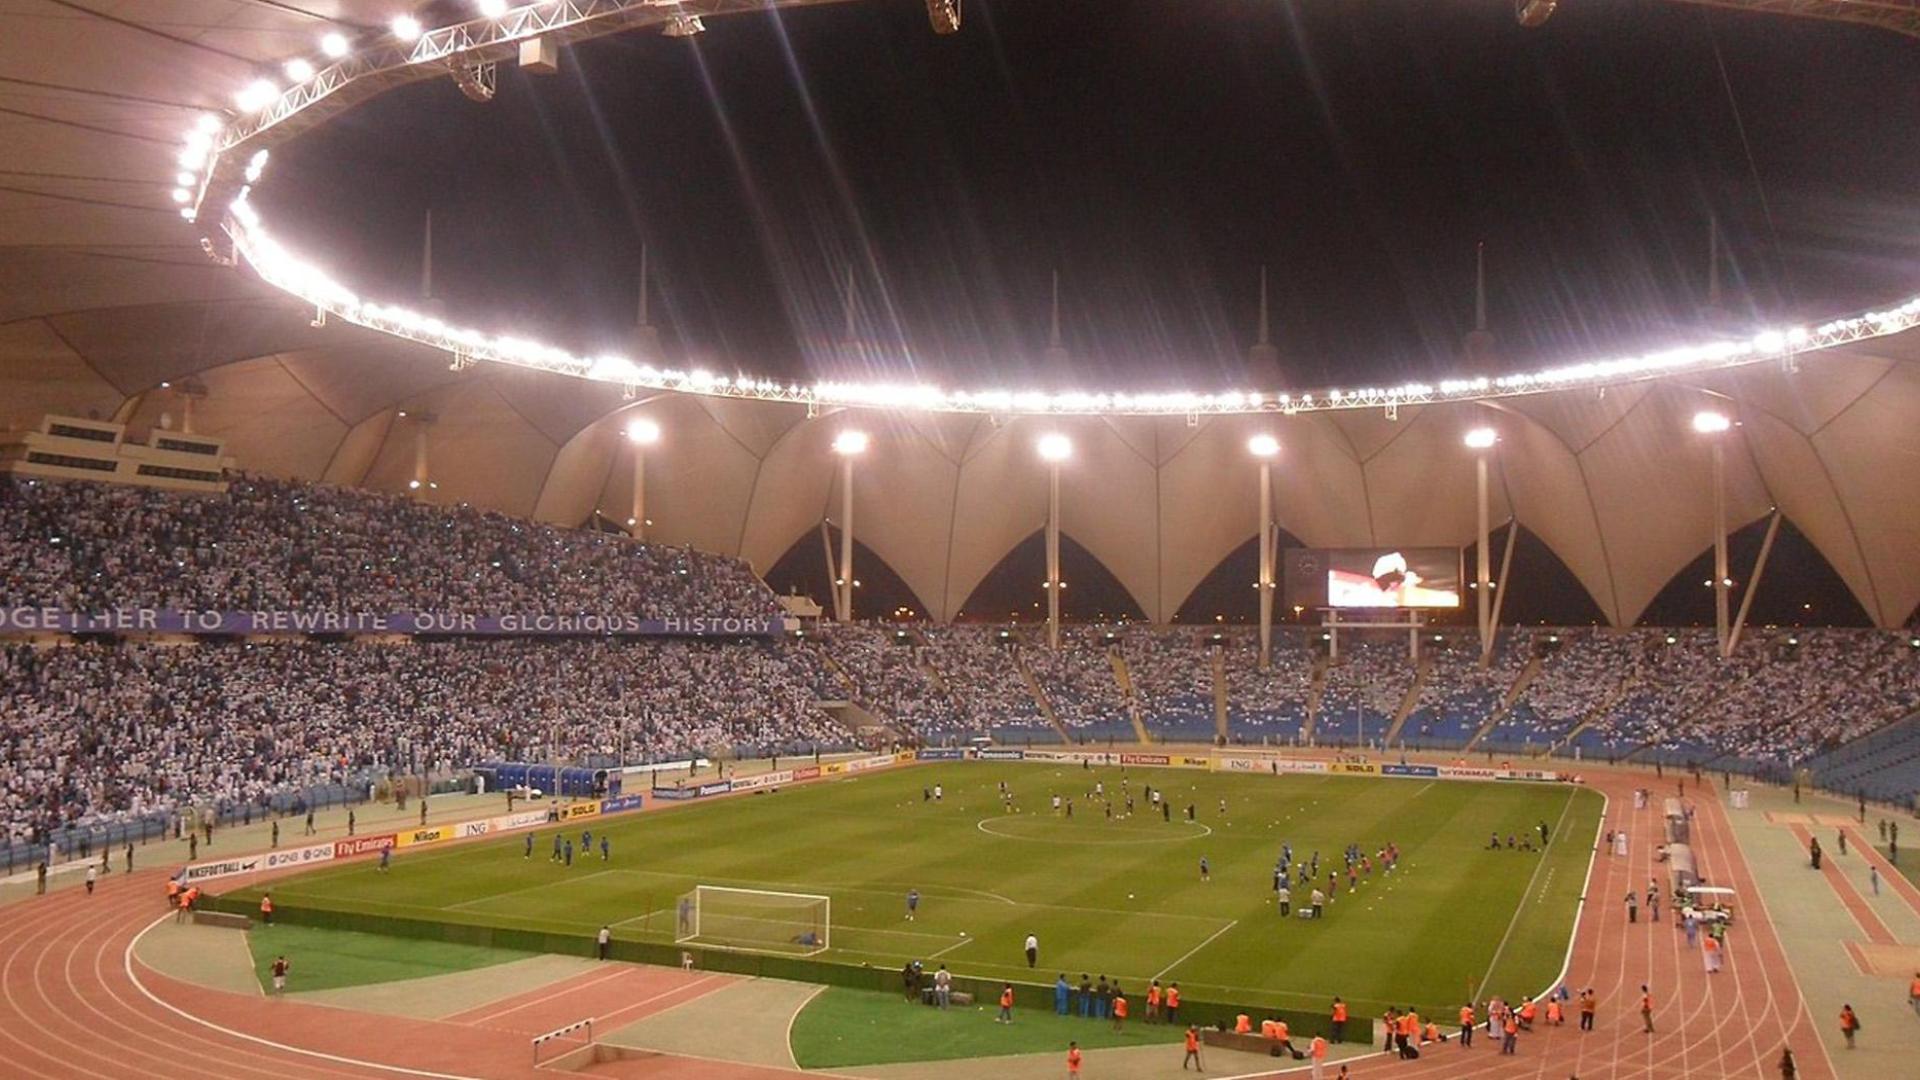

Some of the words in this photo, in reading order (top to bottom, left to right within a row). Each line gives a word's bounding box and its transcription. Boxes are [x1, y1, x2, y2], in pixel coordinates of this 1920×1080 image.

[0, 606, 157, 629] GETHER
[178, 609, 222, 630] TO
[251, 611, 388, 630] REWRITE
[414, 613, 477, 631] OUR
[500, 614, 640, 632] GLORIOUS
[664, 617, 771, 632] HISTORY
[1231, 760, 1250, 769] ING
[413, 831, 441, 843] Nikon
[466, 822, 487, 836] ING
[337, 841, 355, 856] Fly
[355, 836, 395, 852] Emirates
[188, 861, 240, 879] NIKEFOOTBALL
